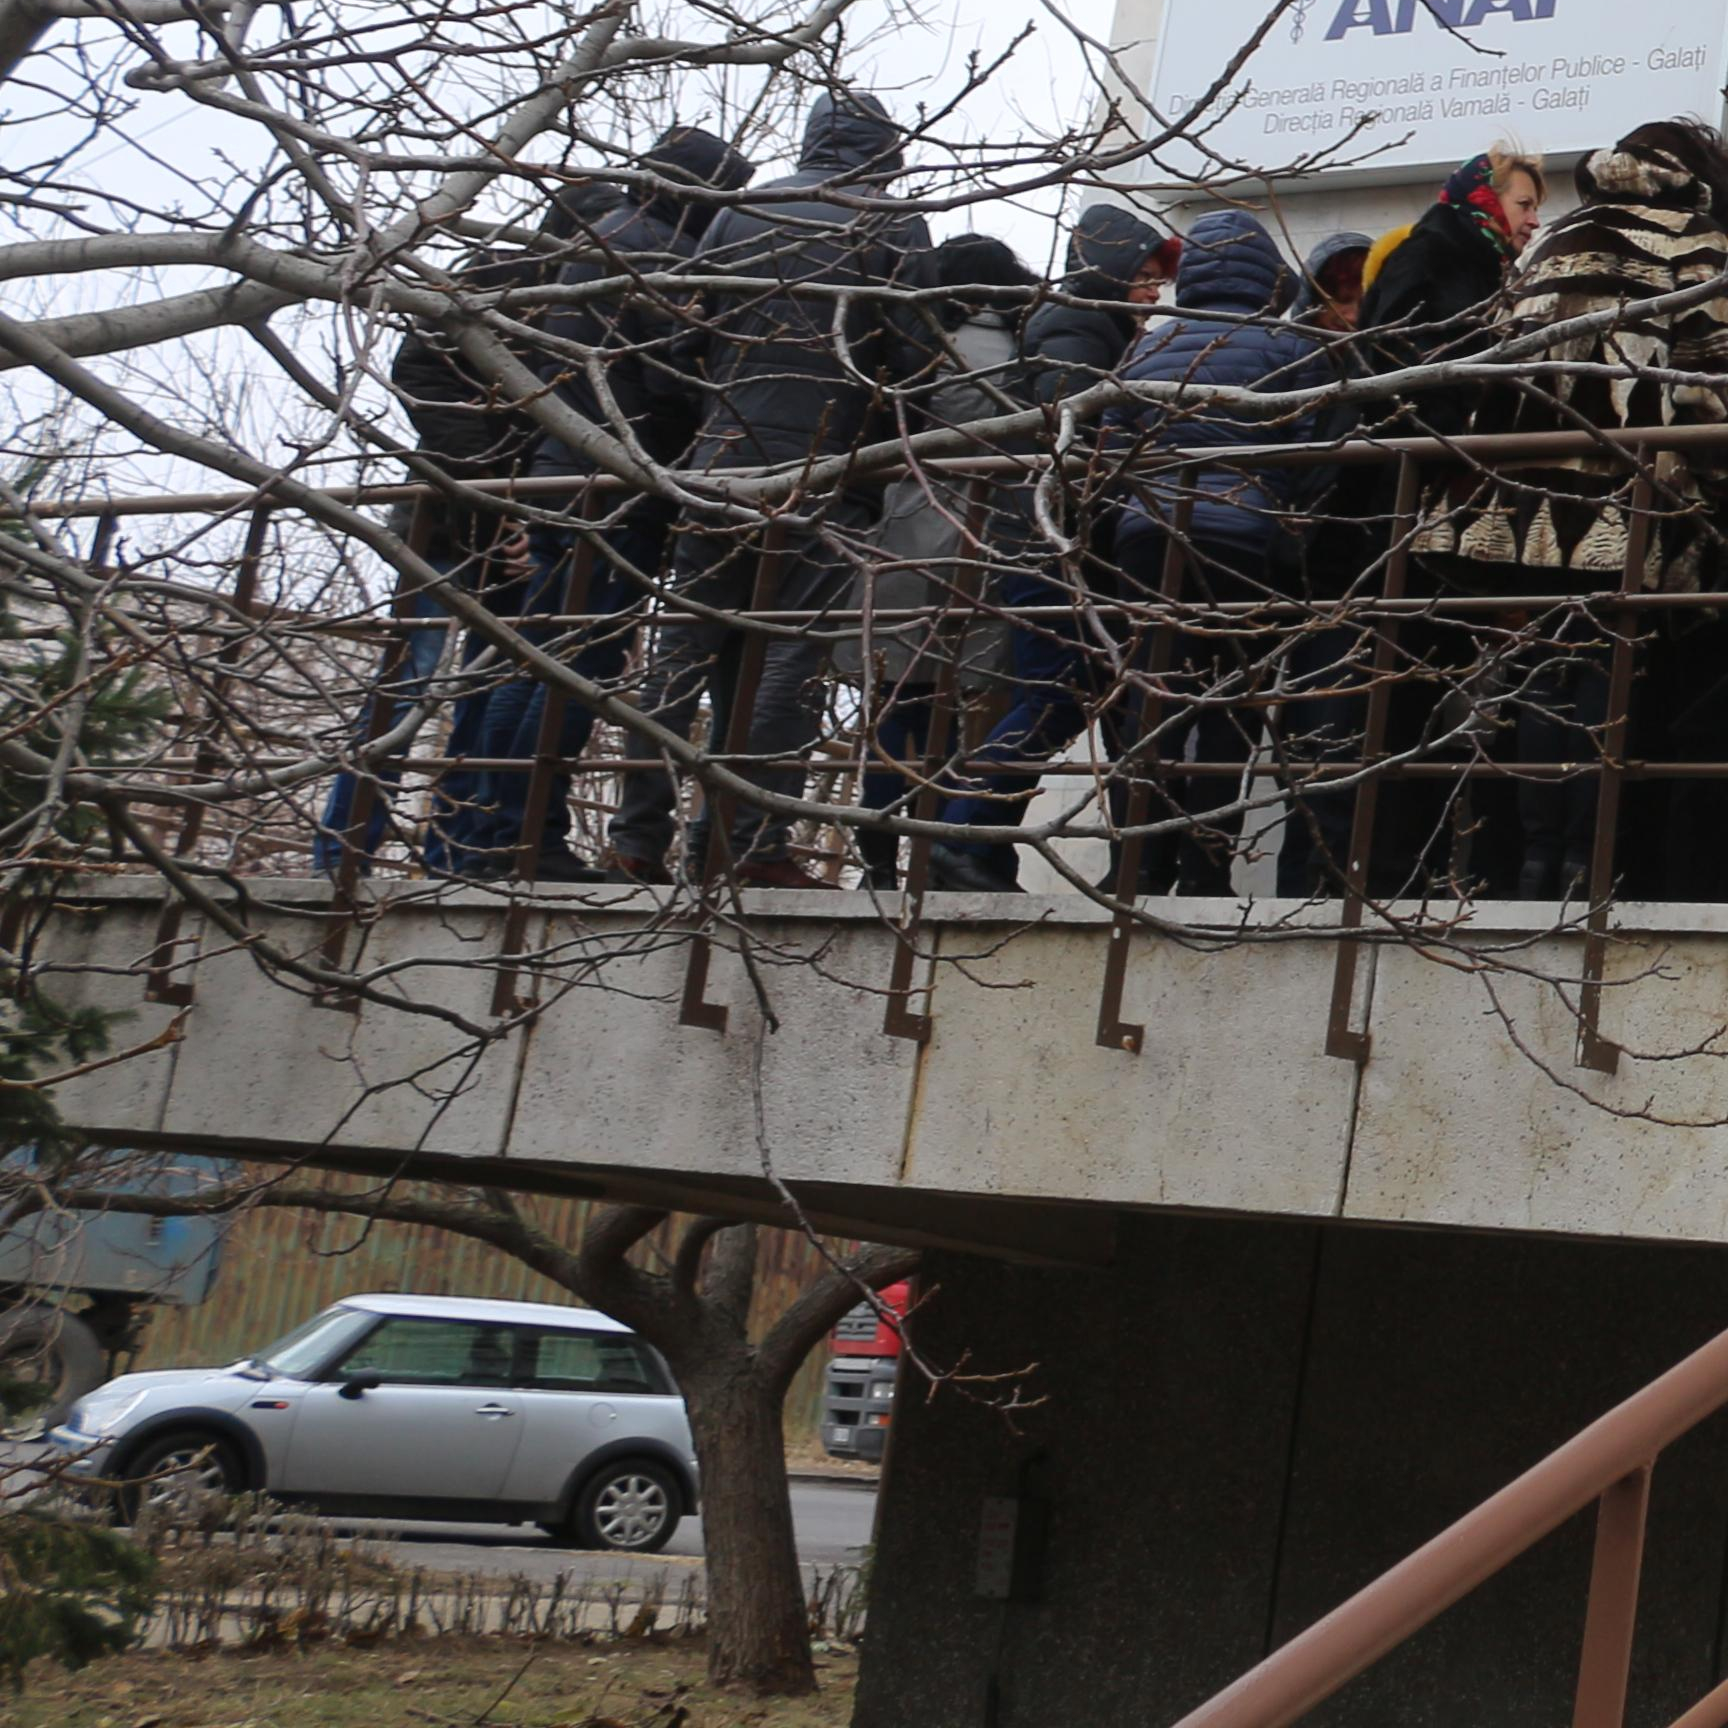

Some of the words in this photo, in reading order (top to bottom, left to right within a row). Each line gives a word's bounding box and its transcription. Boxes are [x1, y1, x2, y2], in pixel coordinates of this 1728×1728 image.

[1332, 73, 1425, 103] Regională
[1430, 73, 1443, 91] a
[1551, 54, 1626, 80] Publice
[1441, 92, 1511, 120] Vamală
